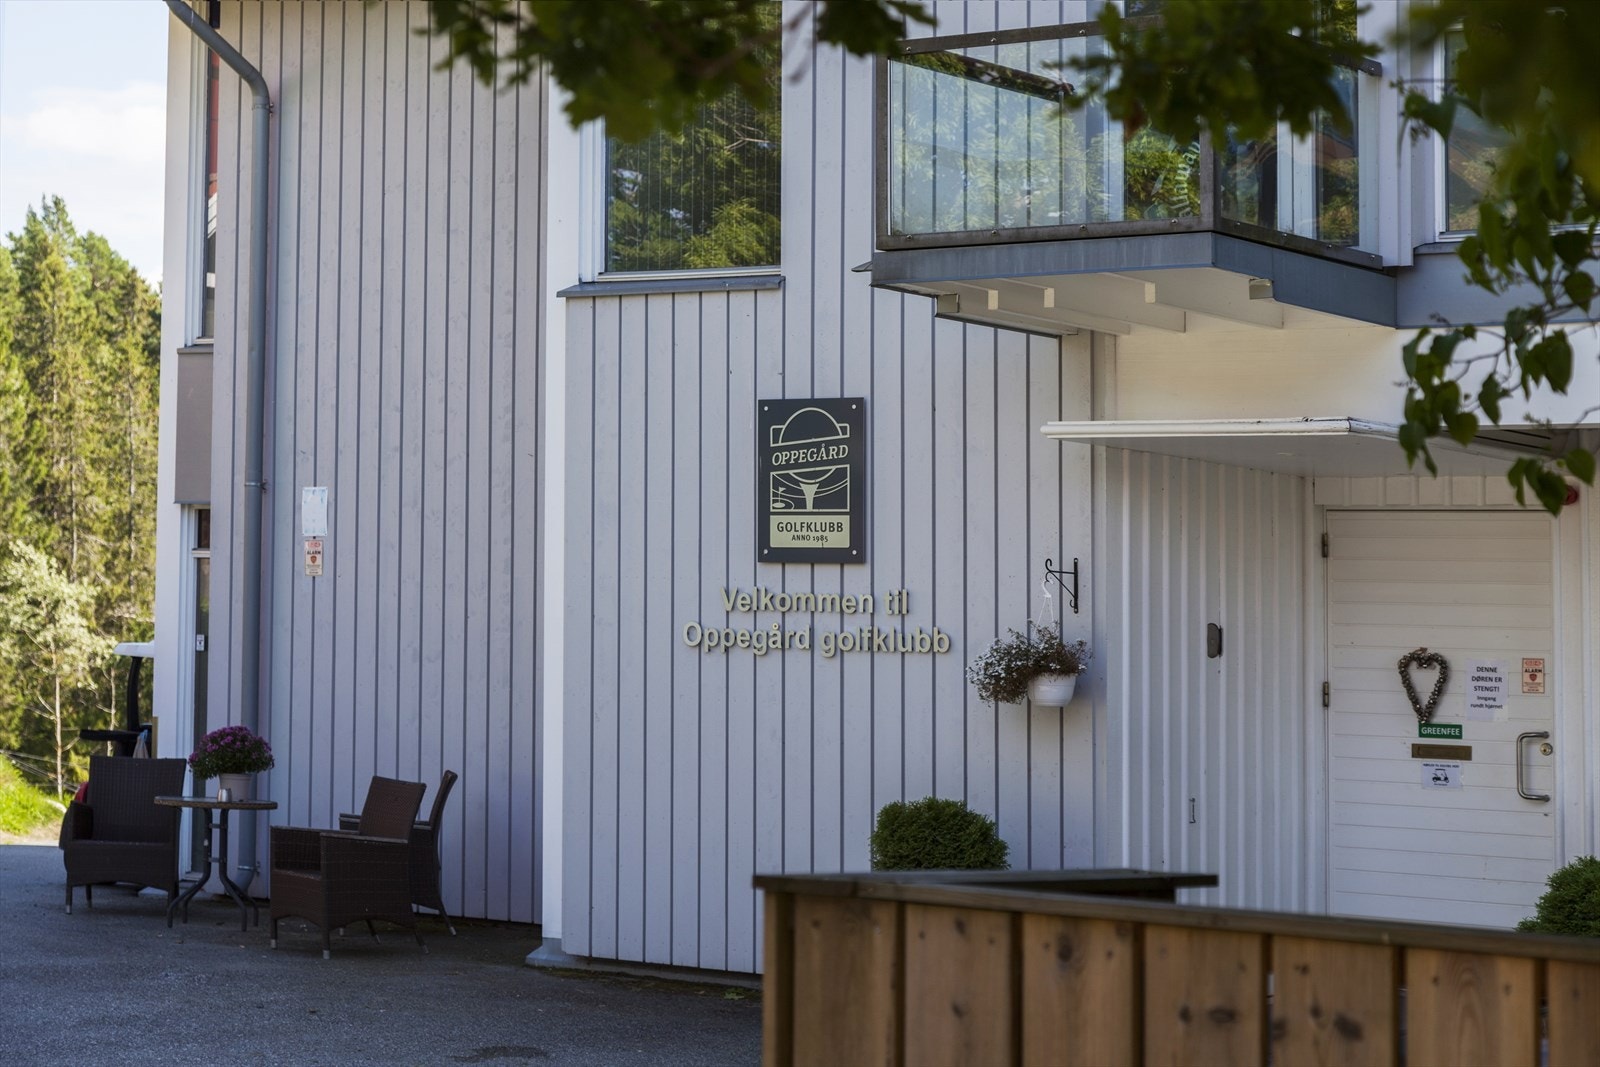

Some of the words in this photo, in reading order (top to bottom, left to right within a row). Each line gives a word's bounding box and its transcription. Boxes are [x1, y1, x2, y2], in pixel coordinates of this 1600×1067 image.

[772, 443, 849, 466] OPPEGÅRD
[777, 521, 844, 533] GOLFKLUBB
[812, 534, 829, 543] 1985
[720, 586, 874, 614] Velkommen
[884, 589, 909, 615] til
[682, 620, 811, 656] Oppegård
[820, 626, 951, 658] golfklubb
[1421, 726, 1460, 736] GREENFEE
